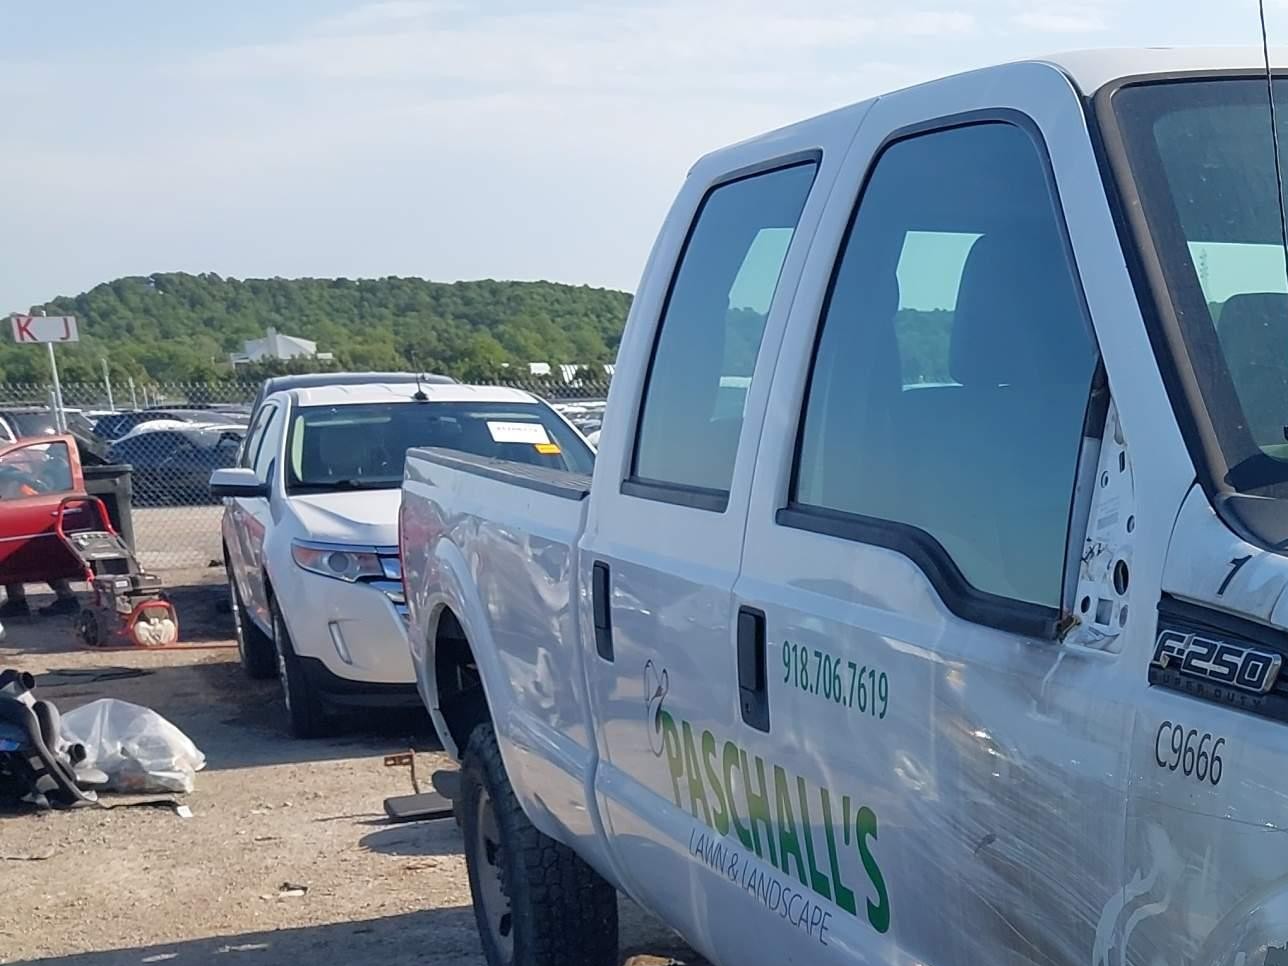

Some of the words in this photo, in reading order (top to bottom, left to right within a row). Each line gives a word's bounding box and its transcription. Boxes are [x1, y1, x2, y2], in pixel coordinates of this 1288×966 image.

[16, 317, 39, 341] K
[59, 317, 70, 340] J
[782, 640, 889, 719] 918.706.7619
[1152, 629, 1282, 693] F-250
[1155, 720, 1226, 786] C9666
[660, 709, 891, 934] PASCHALL'S
[688, 828, 729, 873] LAWN
[727, 852, 739, 881] &
[741, 865, 833, 945] LANDSCAPE
